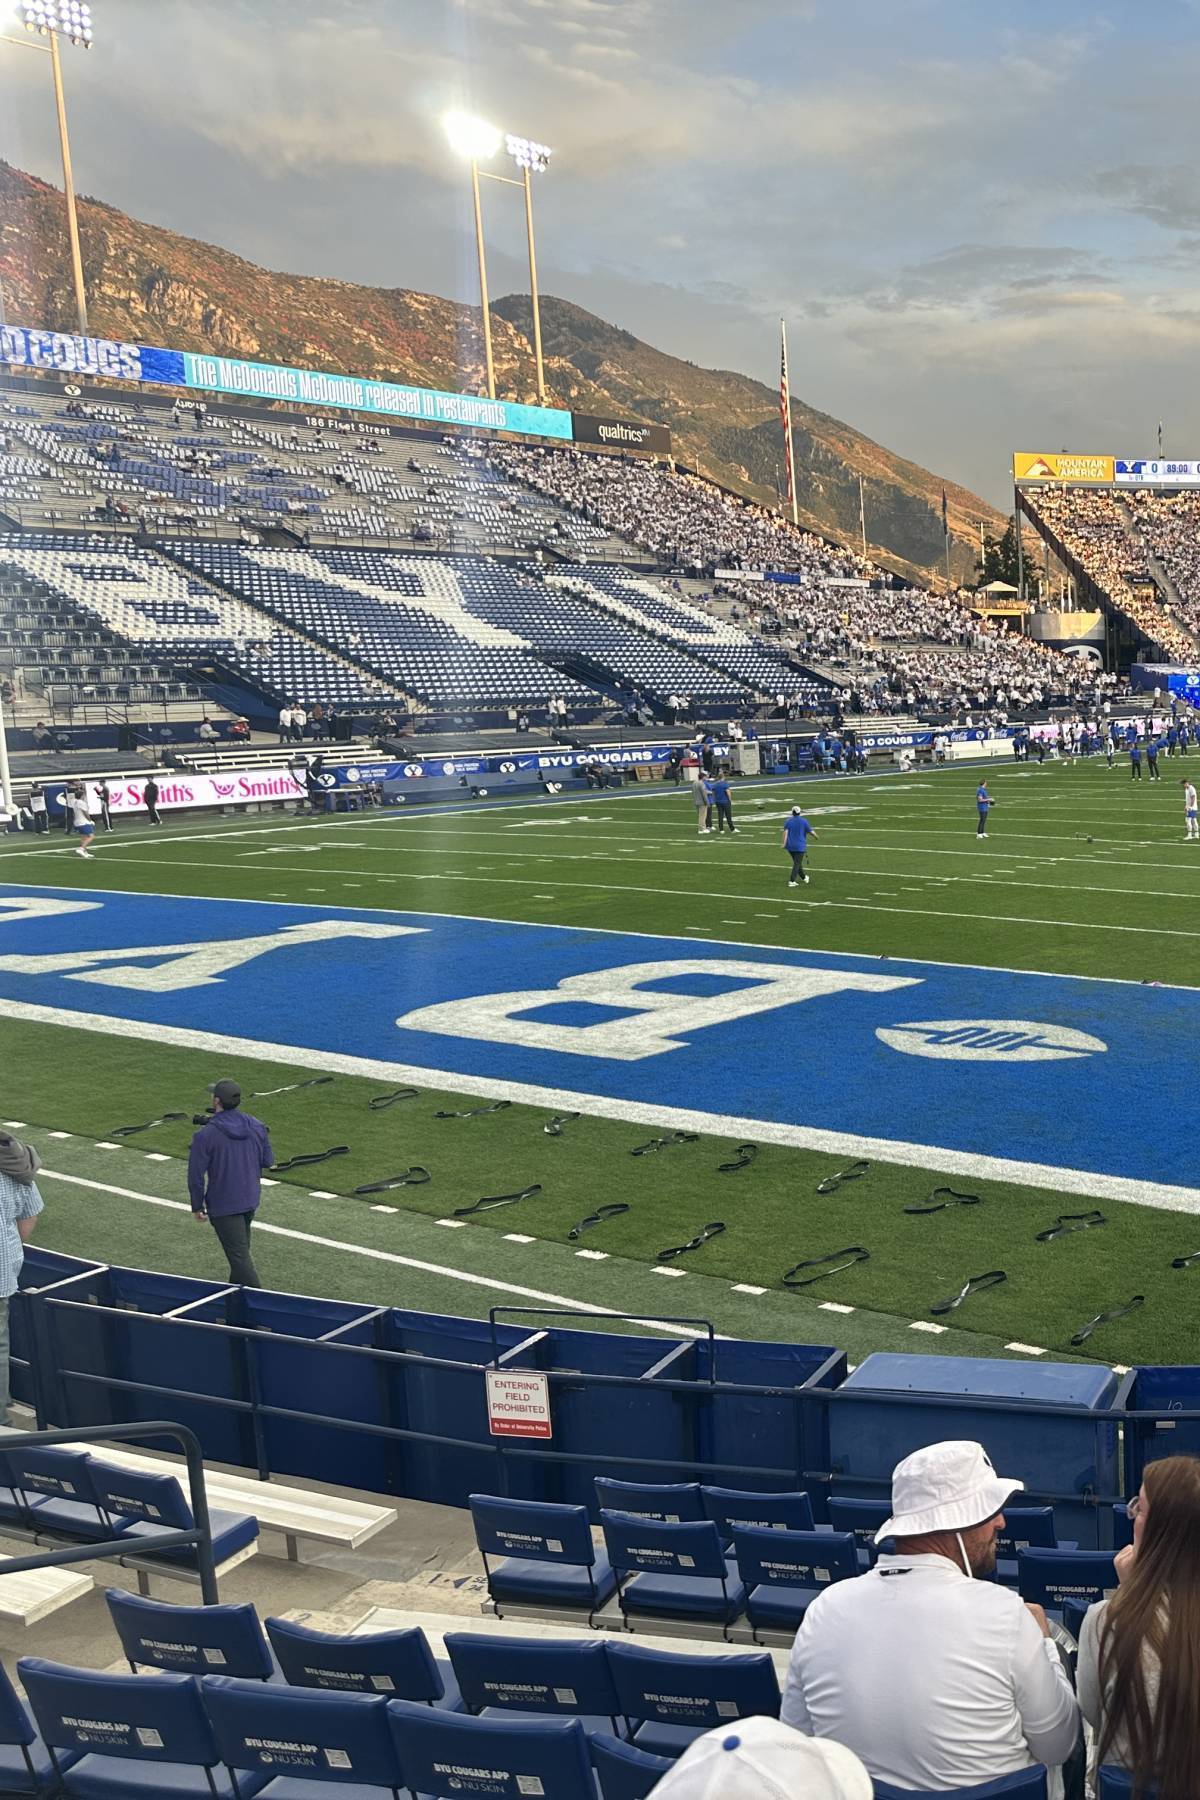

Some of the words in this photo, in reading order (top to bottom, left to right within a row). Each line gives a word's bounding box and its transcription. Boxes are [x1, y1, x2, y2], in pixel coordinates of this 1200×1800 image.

[0, 326, 26, 364] O
[189, 355, 217, 386] The
[219, 358, 298, 397] McDonalds
[299, 369, 364, 407] McDouble
[365, 384, 420, 413] released
[423, 393, 434, 417] in
[437, 398, 507, 427] restaurants
[305, 416, 325, 428] 186
[359, 422, 391, 436] Street
[598, 424, 642, 443] qualtrics
[1056, 459, 1108, 469] MOUNTAIN
[1060, 468, 1104, 479] AMERICA
[875, 735, 913, 746] COUGS
[538, 756, 573, 768] BYU
[576, 751, 653, 766] COUGARS
[714, 747, 729, 756] BY
[239, 775, 302, 797] Smith's
[128, 784, 194, 806] Sith's
[495, 1380, 539, 1391] ENTERING
[505, 1392, 530, 1401] FIELD
[493, 1402, 545, 1414] PROHIBITED
[61, 1716, 76, 1726] BYU
[77, 1718, 112, 1730] COUGARS
[113, 1722, 130, 1732] APP
[245, 1737, 260, 1747] BYU
[262, 1739, 299, 1751] COUGARS
[300, 1743, 318, 1753] APP
[274, 1755, 288, 1764] NU
[290, 1756, 316, 1766] SKIN
[433, 1763, 449, 1774] BYU
[451, 1765, 490, 1779] COUGARS
[491, 1770, 510, 1781] APP
[463, 1781, 477, 1791] NU
[479, 1782, 505, 1793] SKIN
